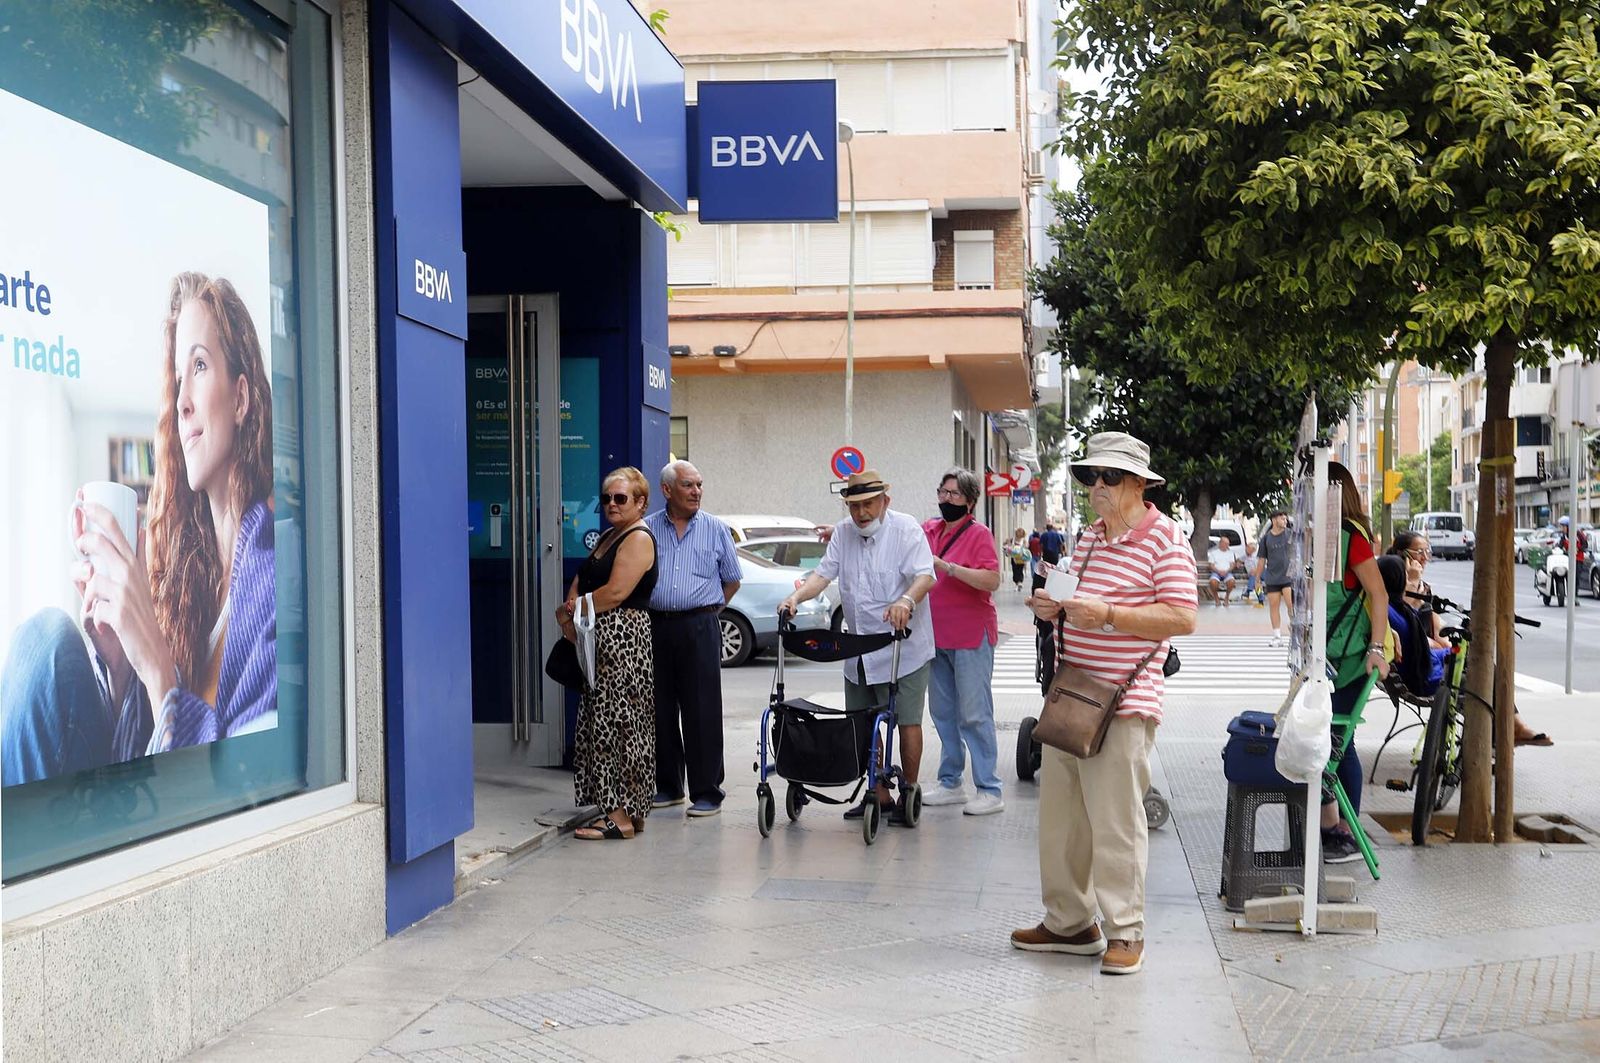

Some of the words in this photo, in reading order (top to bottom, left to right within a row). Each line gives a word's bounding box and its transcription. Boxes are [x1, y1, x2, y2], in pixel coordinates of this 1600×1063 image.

[560, 0, 643, 123] BBVA
[711, 130, 824, 167] BBVA
[415, 258, 452, 303] BBVA
[13, 335, 80, 379] nada
[475, 367, 509, 379] BBVA
[649, 364, 667, 390] BBVA
[484, 400, 496, 409] Es
[497, 400, 507, 409] el
